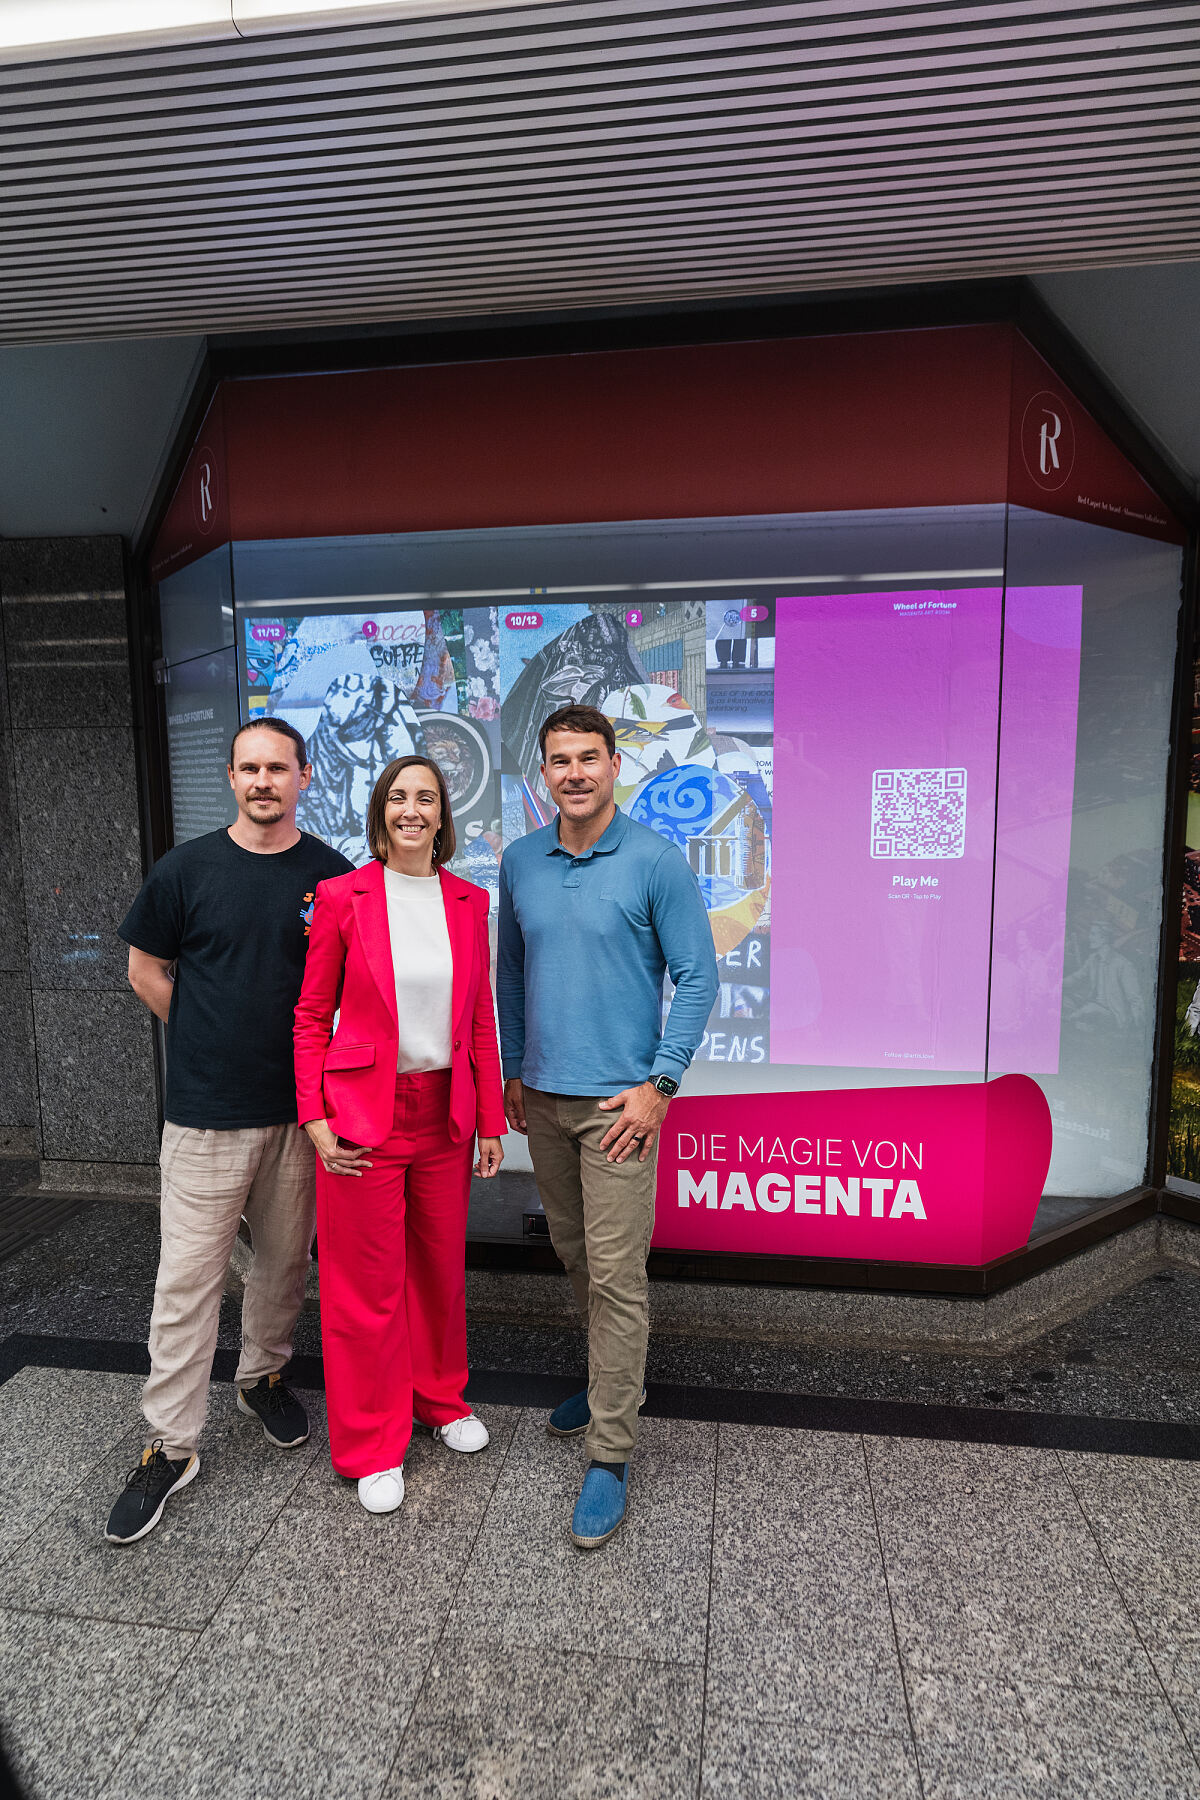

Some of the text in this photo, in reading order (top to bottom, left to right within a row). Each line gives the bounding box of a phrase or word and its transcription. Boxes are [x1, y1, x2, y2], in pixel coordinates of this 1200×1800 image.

[893, 601, 957, 610] Wheel of Fortune
[631, 614, 638, 623] 2
[750, 609, 757, 618] 5
[510, 615, 537, 626] 10/12
[367, 622, 373, 633] 1
[256, 628, 281, 638] 11/12
[892, 875, 939, 889] Play Me
[929, 893, 942, 901] Play
[678, 1133, 923, 1171] DIE MAGIE VON
[677, 1169, 928, 1220] MAGENTA
